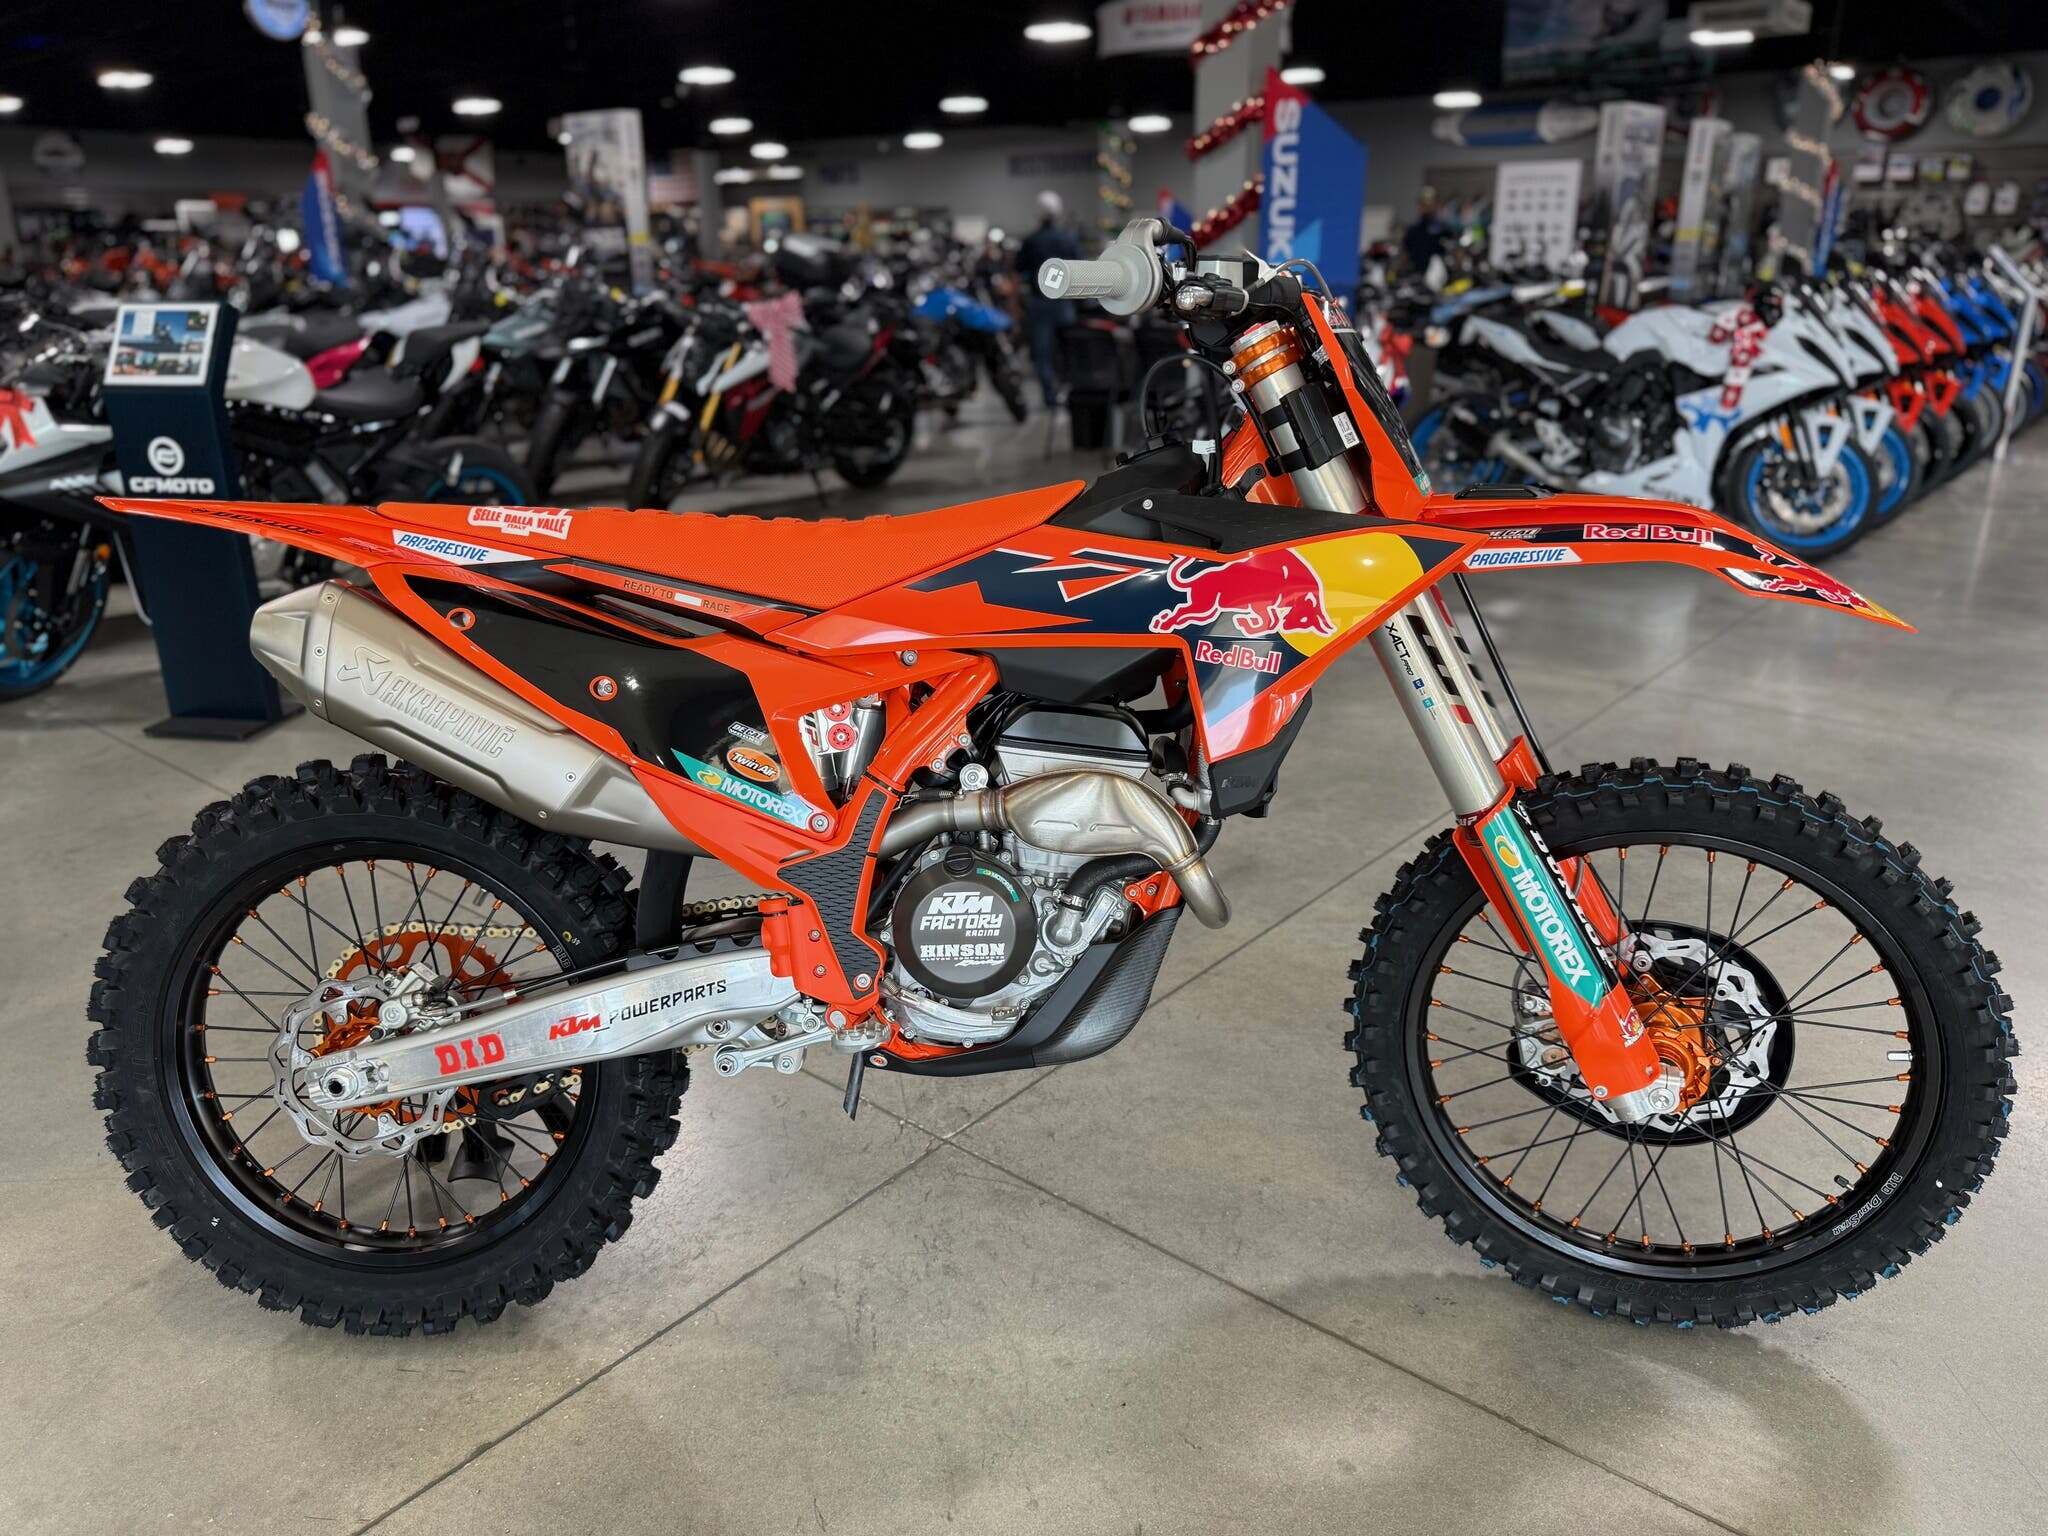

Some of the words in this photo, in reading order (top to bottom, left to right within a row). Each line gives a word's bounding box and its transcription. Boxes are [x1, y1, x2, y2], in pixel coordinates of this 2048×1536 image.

[1266, 98, 1302, 261] SUZUK
[129, 476, 215, 494] CFMOTO
[473, 508, 502, 521] SELLE
[504, 514, 534, 527] DALLA
[536, 517, 566, 534] VALLE
[1583, 523, 1649, 540] Red
[1650, 524, 1714, 544] Bull
[398, 534, 490, 562] PROGRESSIVE
[1469, 549, 1568, 566] PROGRESSIVE
[623, 579, 658, 596] READY
[659, 588, 674, 600] TO
[702, 599, 731, 613] RACE
[1195, 640, 1239, 667] Red
[1238, 647, 1282, 674] Bull
[732, 752, 760, 770] Twin
[757, 765, 777, 777] Air
[720, 777, 806, 826] MOTOREX
[927, 892, 994, 914] KTM
[920, 914, 1003, 930] FACTORY
[1512, 868, 1592, 987] MOTOREX
[920, 943, 1005, 957] HINSON
[549, 1013, 601, 1040] KTM
[609, 980, 727, 1024] POWERPARTS
